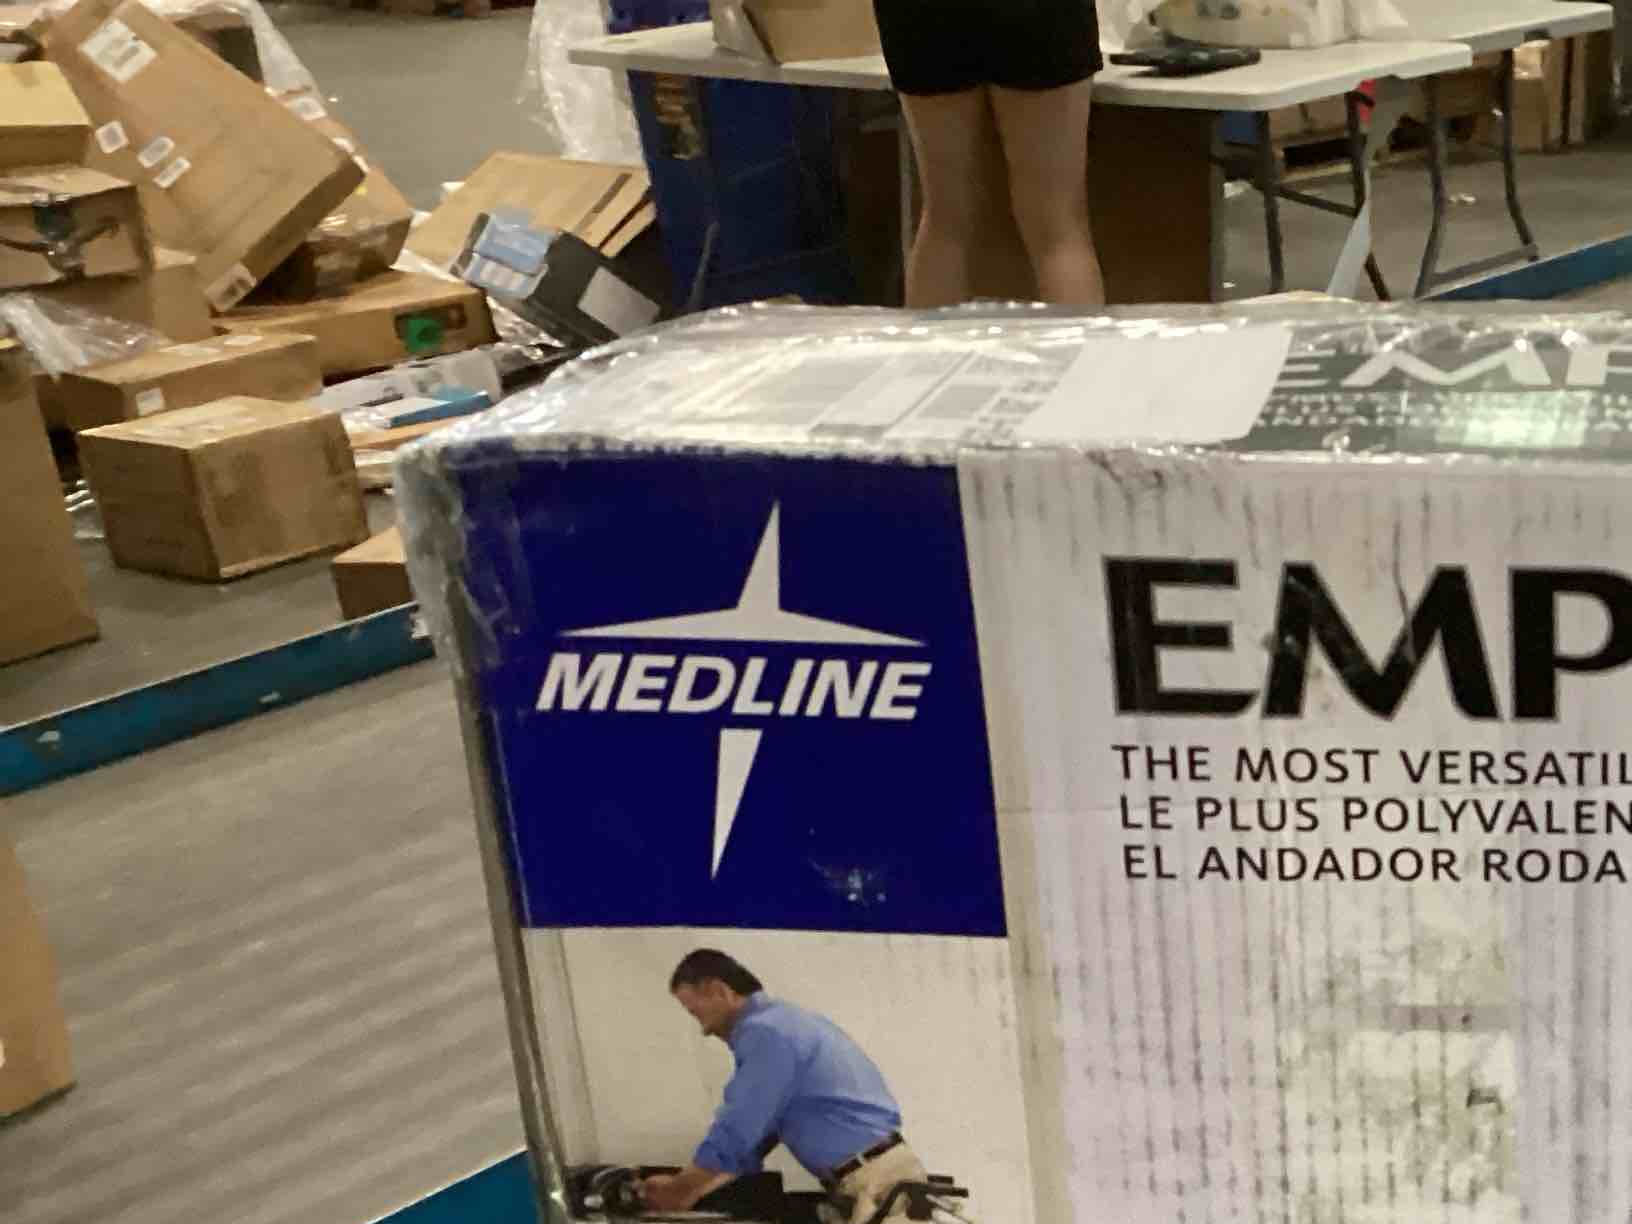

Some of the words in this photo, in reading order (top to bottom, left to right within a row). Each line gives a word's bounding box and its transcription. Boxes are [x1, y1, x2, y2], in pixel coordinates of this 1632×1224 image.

[535, 652, 932, 719] MEDLINE
[1112, 745, 1211, 782] THE
[1235, 748, 1379, 784] MOST
[1120, 795, 1172, 830] LE
[1198, 797, 1319, 833] PLUS
[1123, 845, 1175, 881] EL
[1198, 847, 1461, 884] ANDADOR
